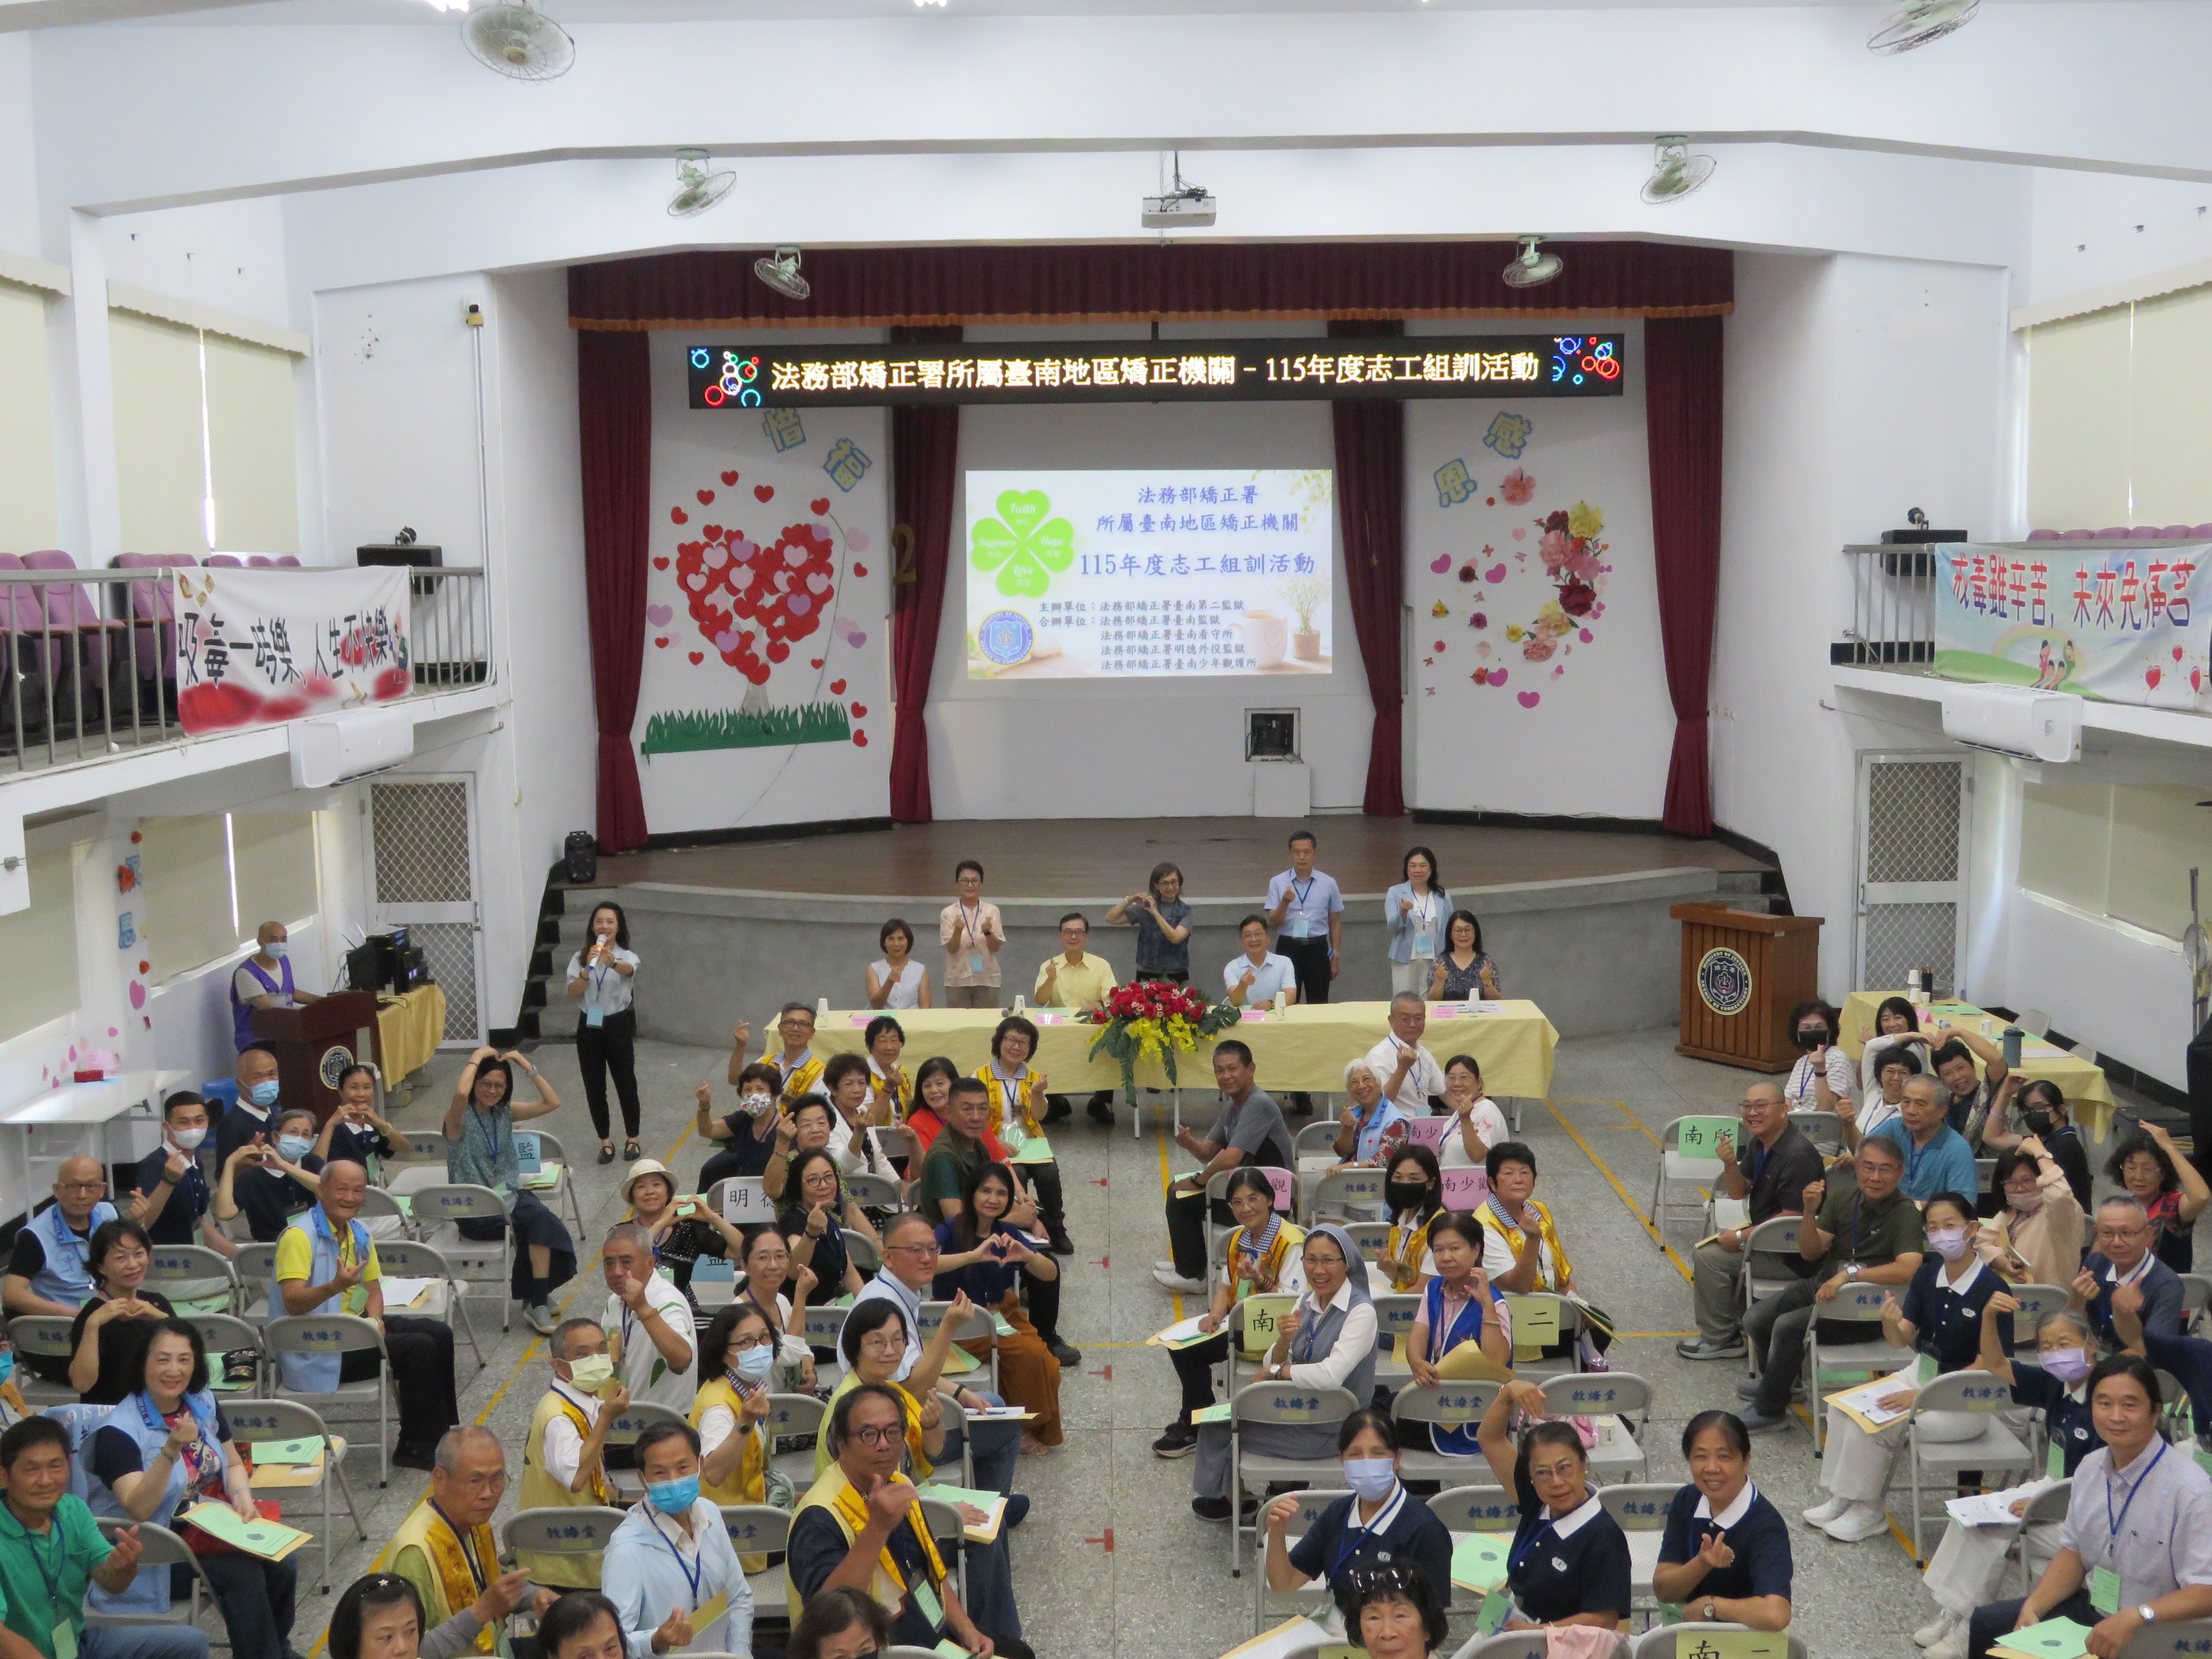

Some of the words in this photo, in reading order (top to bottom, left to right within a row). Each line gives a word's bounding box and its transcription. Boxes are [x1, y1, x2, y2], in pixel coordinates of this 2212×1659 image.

[771, 355, 1236, 390] 法務部矯正署所屬臺南地區矯正機關
[1266, 352, 1539, 382] 115年度志工組訓活動
[1138, 486, 1258, 504] 法務部矯正署
[1097, 512, 1298, 533] 所屬臺南地區矯正機關
[1081, 552, 1315, 577] 115年度志工組訓活動
[2072, 557, 2197, 631] 未來免痛苦
[315, 604, 389, 680] 人生不快樂
[1101, 628, 1233, 641] 法務部矯正署臺南看守所
[1101, 643, 1245, 656] 法務部矯正署明德外役監獄
[1101, 657, 1257, 670] 法務部矯正署臺南少年觀護所
[1703, 951, 1723, 969] MINISTRY
[1731, 955, 1747, 976] JUSTICE
[1701, 979, 1712, 1002] AGENCY
[1720, 987, 1748, 1011] CORRECTIONS
